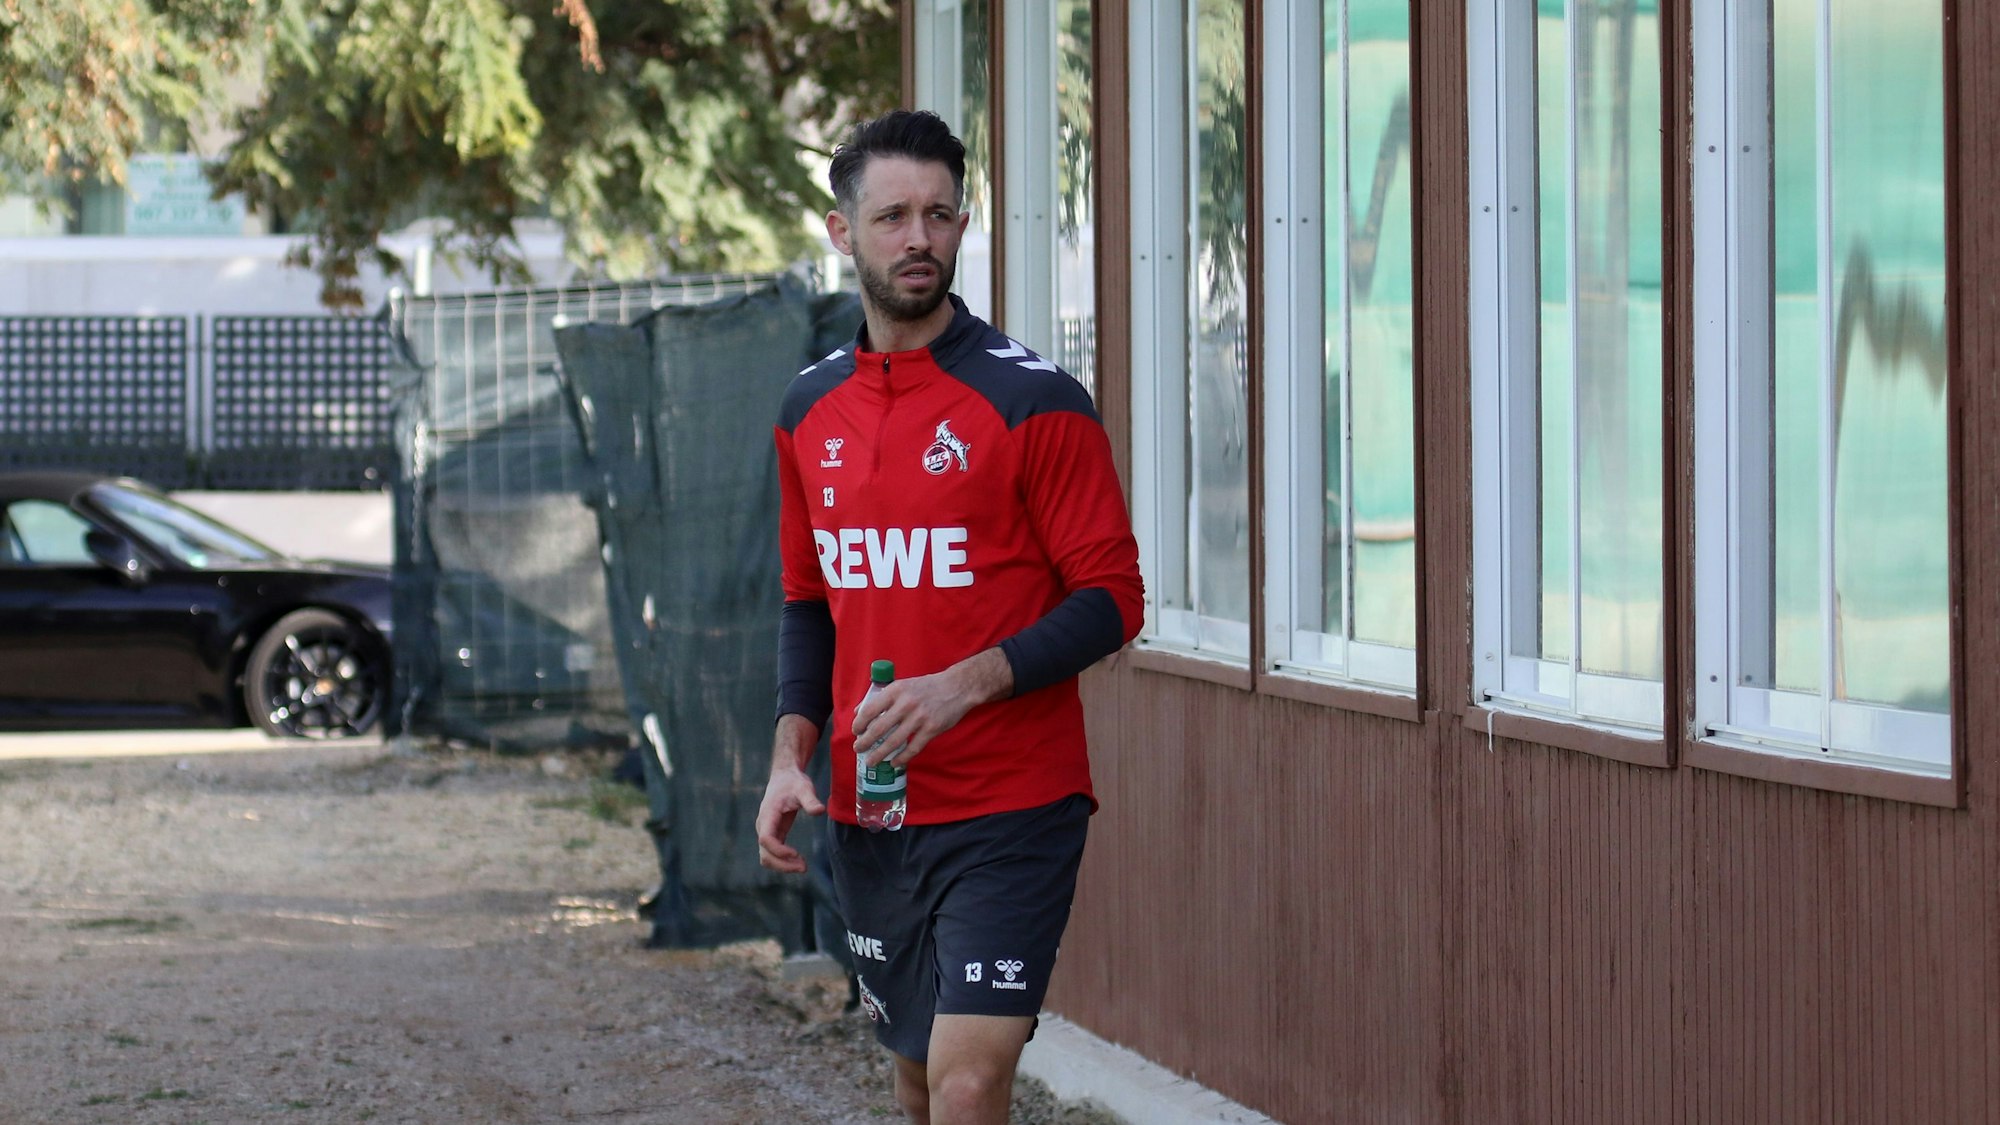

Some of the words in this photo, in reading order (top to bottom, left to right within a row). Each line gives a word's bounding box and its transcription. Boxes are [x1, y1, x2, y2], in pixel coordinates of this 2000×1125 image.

[823, 487, 834, 507] 13
[813, 527, 974, 589] REWE
[964, 962, 982, 982] 13
[992, 980, 1026, 990] hummel
